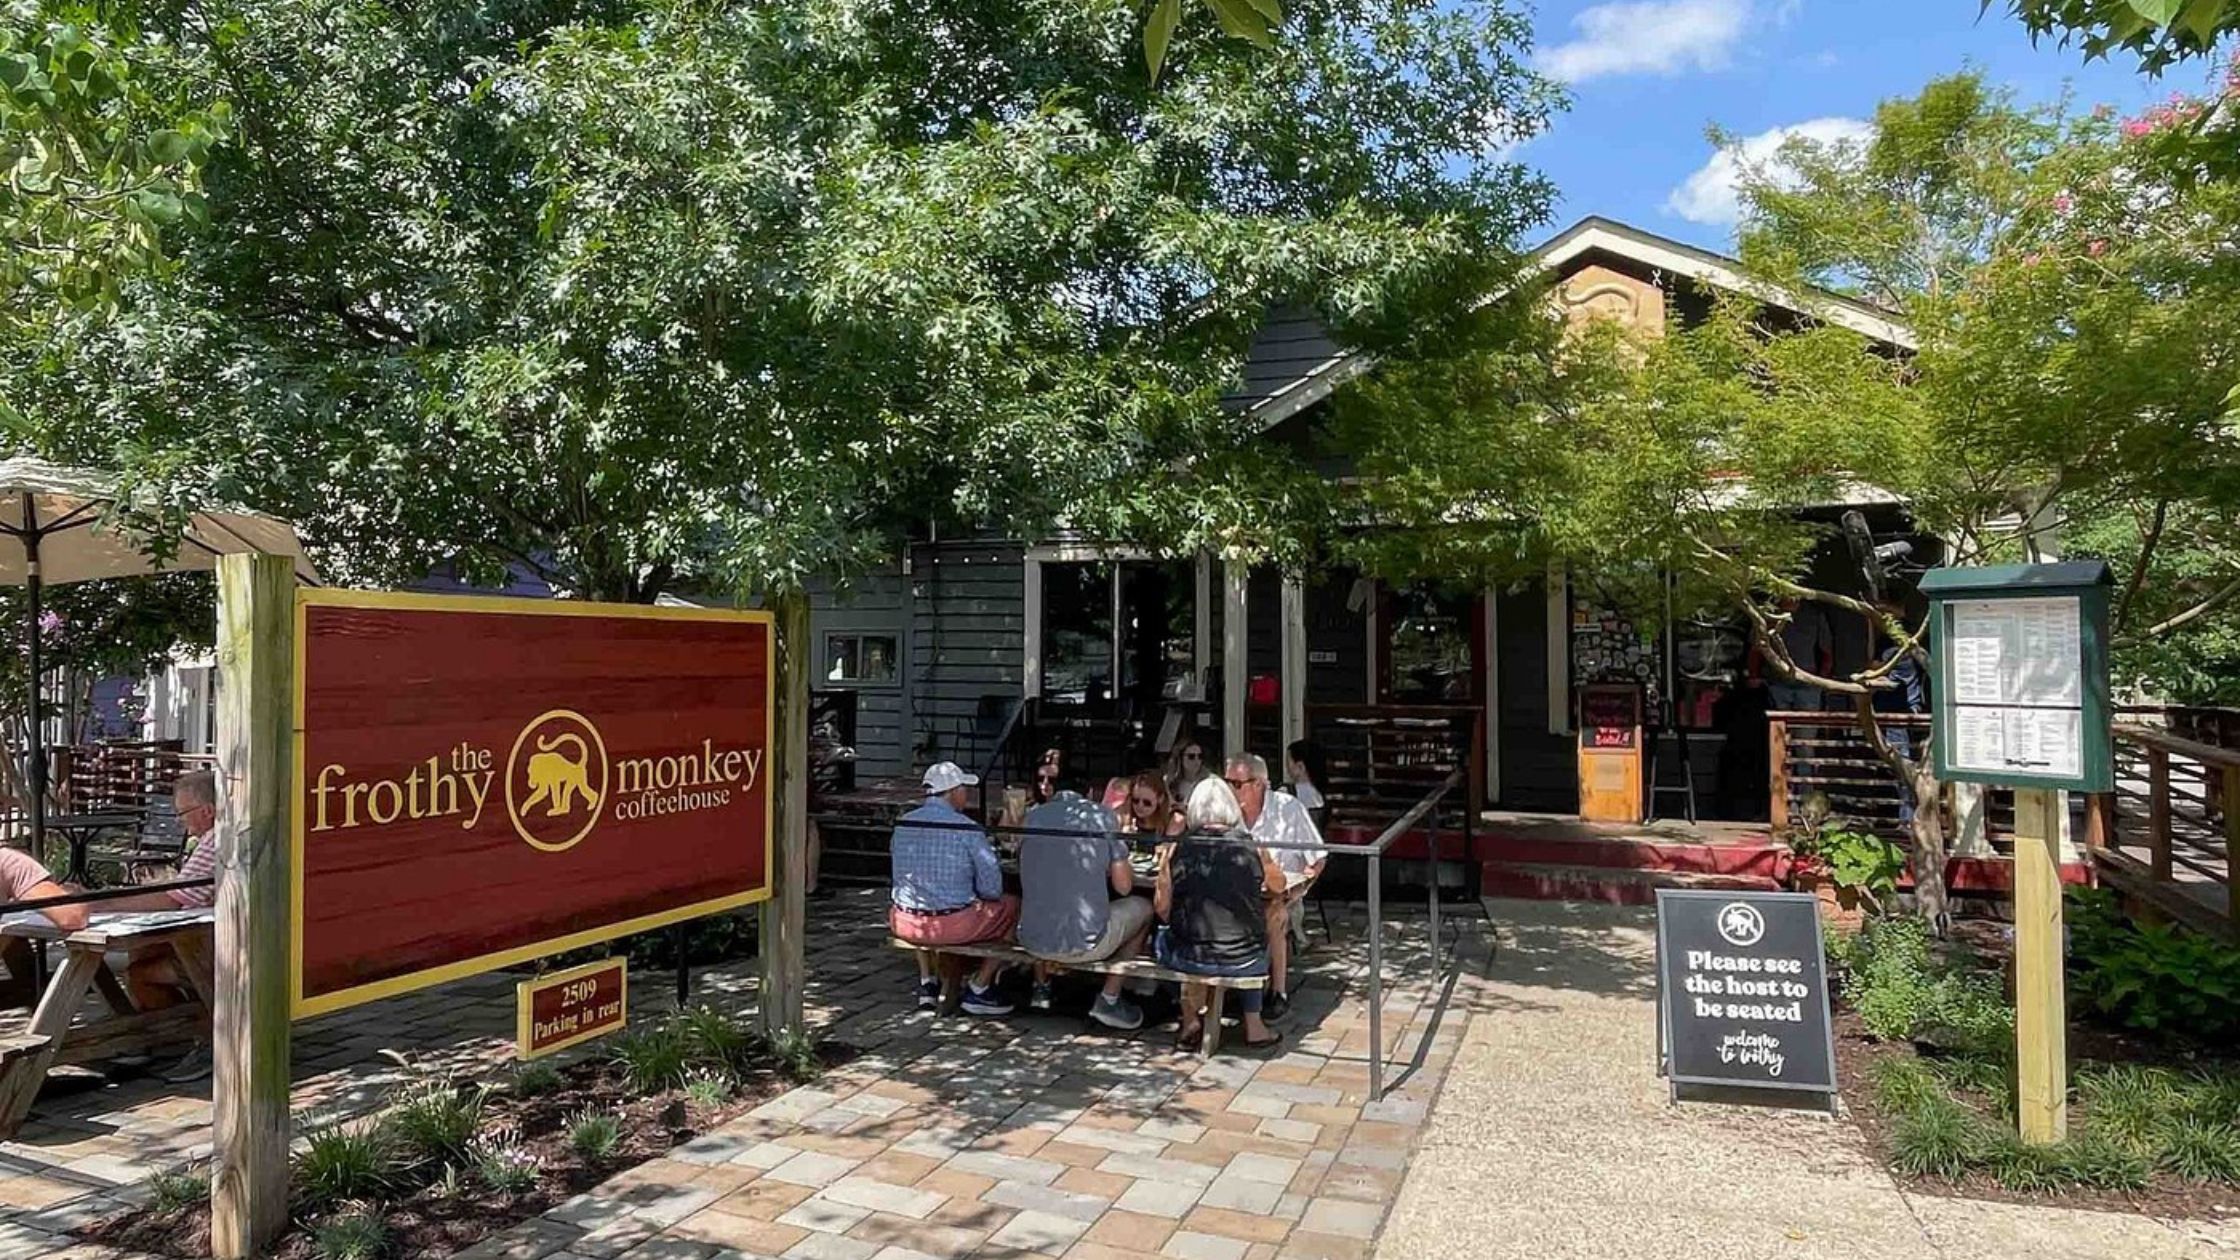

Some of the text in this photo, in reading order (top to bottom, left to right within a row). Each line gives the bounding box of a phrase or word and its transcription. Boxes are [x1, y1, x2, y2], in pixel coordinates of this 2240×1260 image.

[451, 742, 492, 772] the
[310, 738, 762, 832] frothy monkey
[615, 787, 730, 820] coffeehouse
[1688, 950, 1801, 973] Please see
[562, 979, 597, 1007] 2509
[1685, 974, 1808, 998] the host to
[535, 1000, 620, 1040] Parking in rear
[1695, 997, 1801, 1021] be seated
[1723, 1029, 1780, 1048] welcome
[1716, 1044, 1784, 1077] to frothy
